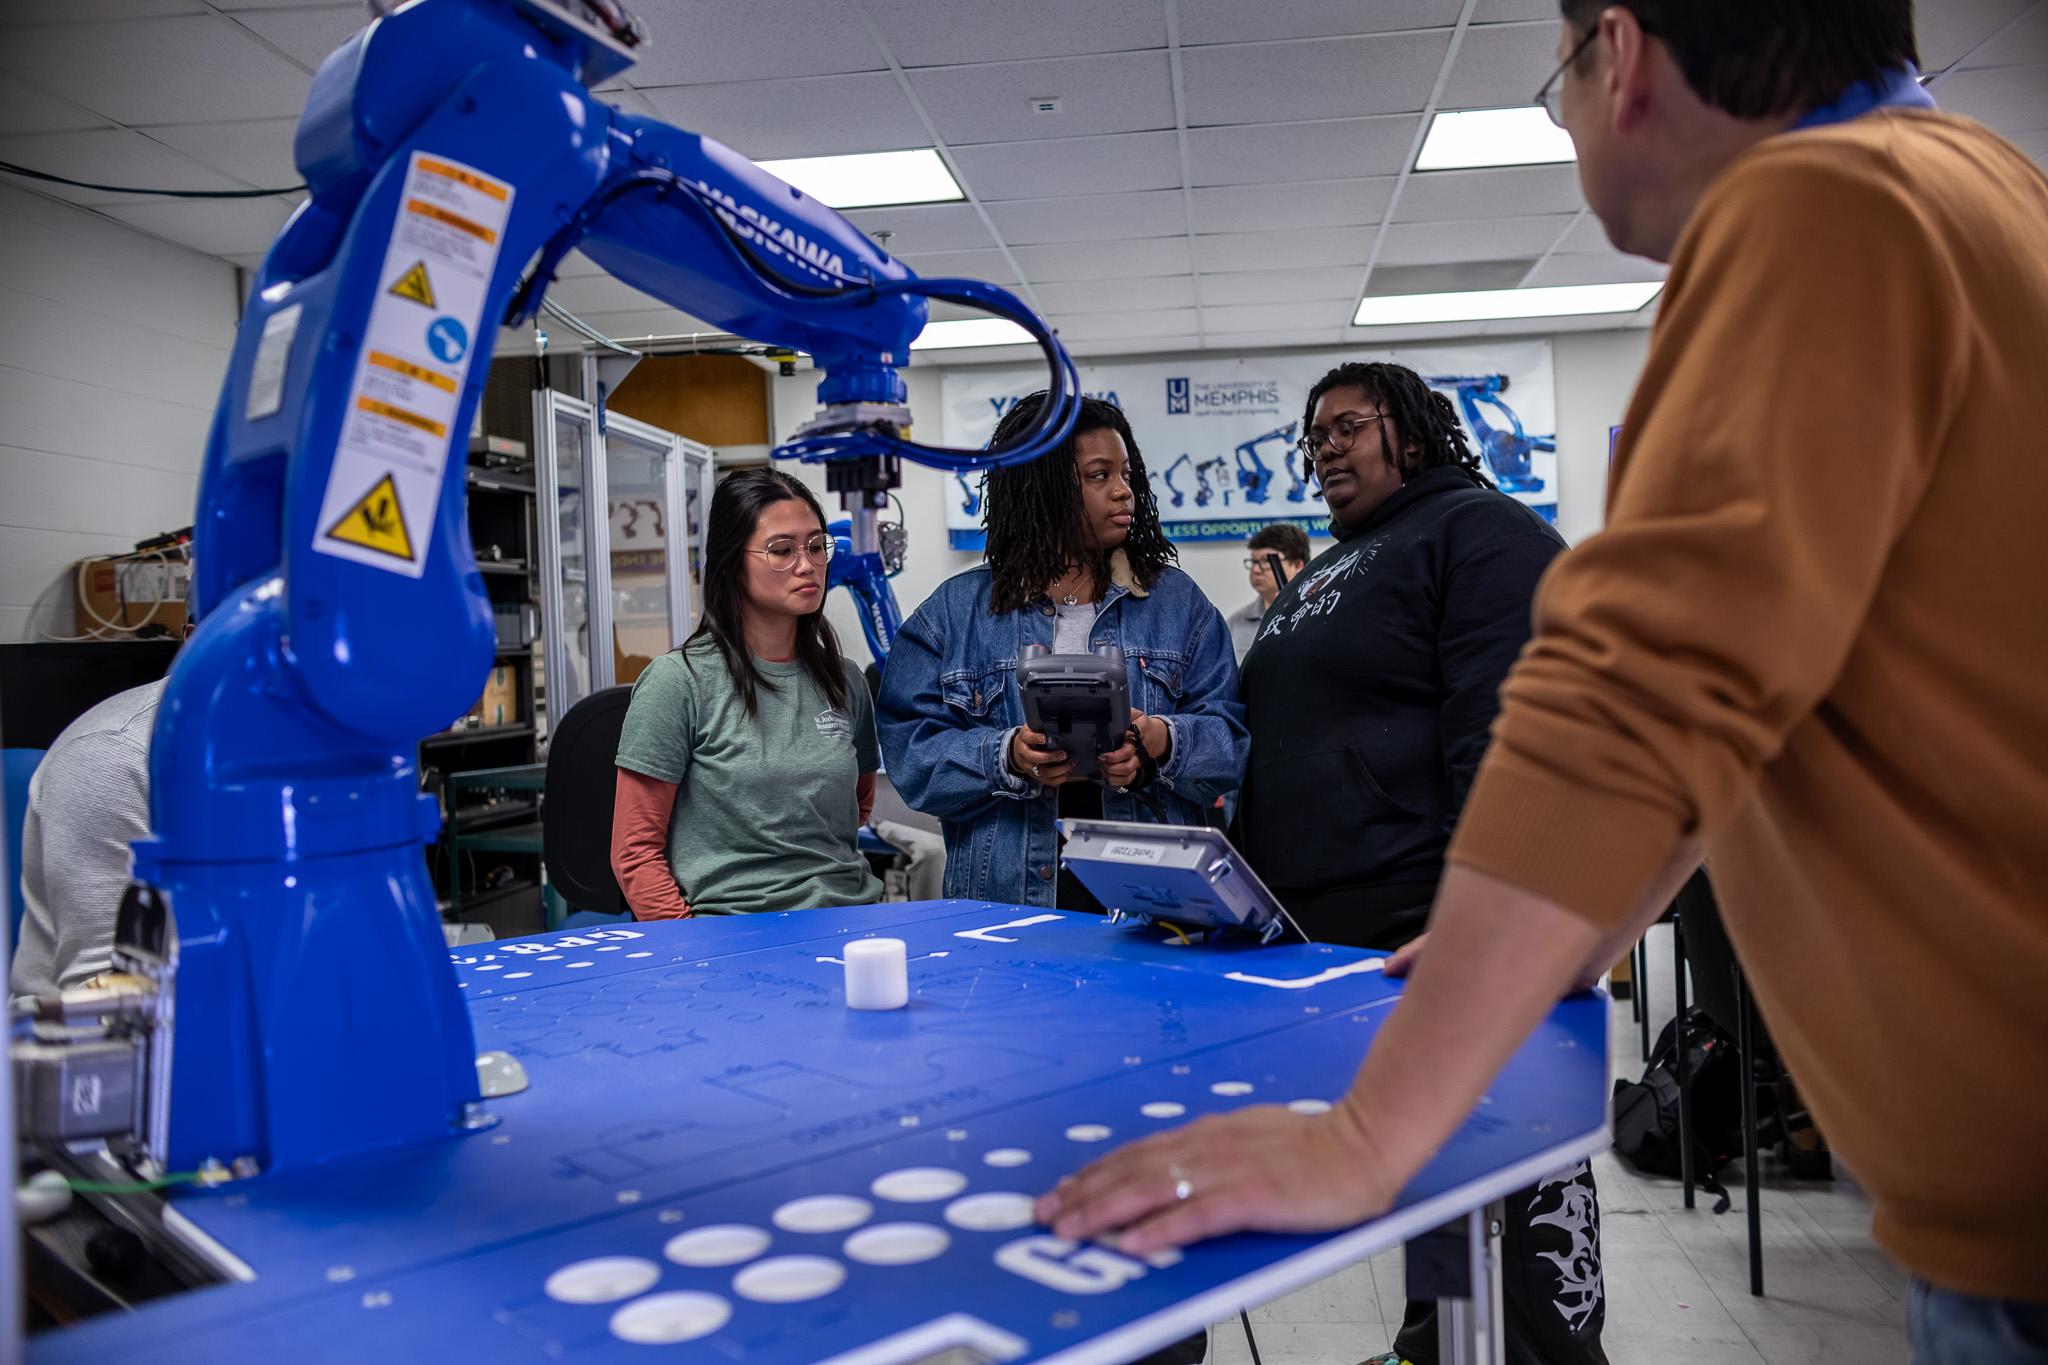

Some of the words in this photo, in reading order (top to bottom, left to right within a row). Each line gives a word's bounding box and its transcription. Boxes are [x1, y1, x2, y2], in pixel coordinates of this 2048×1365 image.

[1194, 388, 1280, 407] MEMPHIS
[1259, 590, 1341, 641] 致命的
[498, 930, 645, 955] GP8
